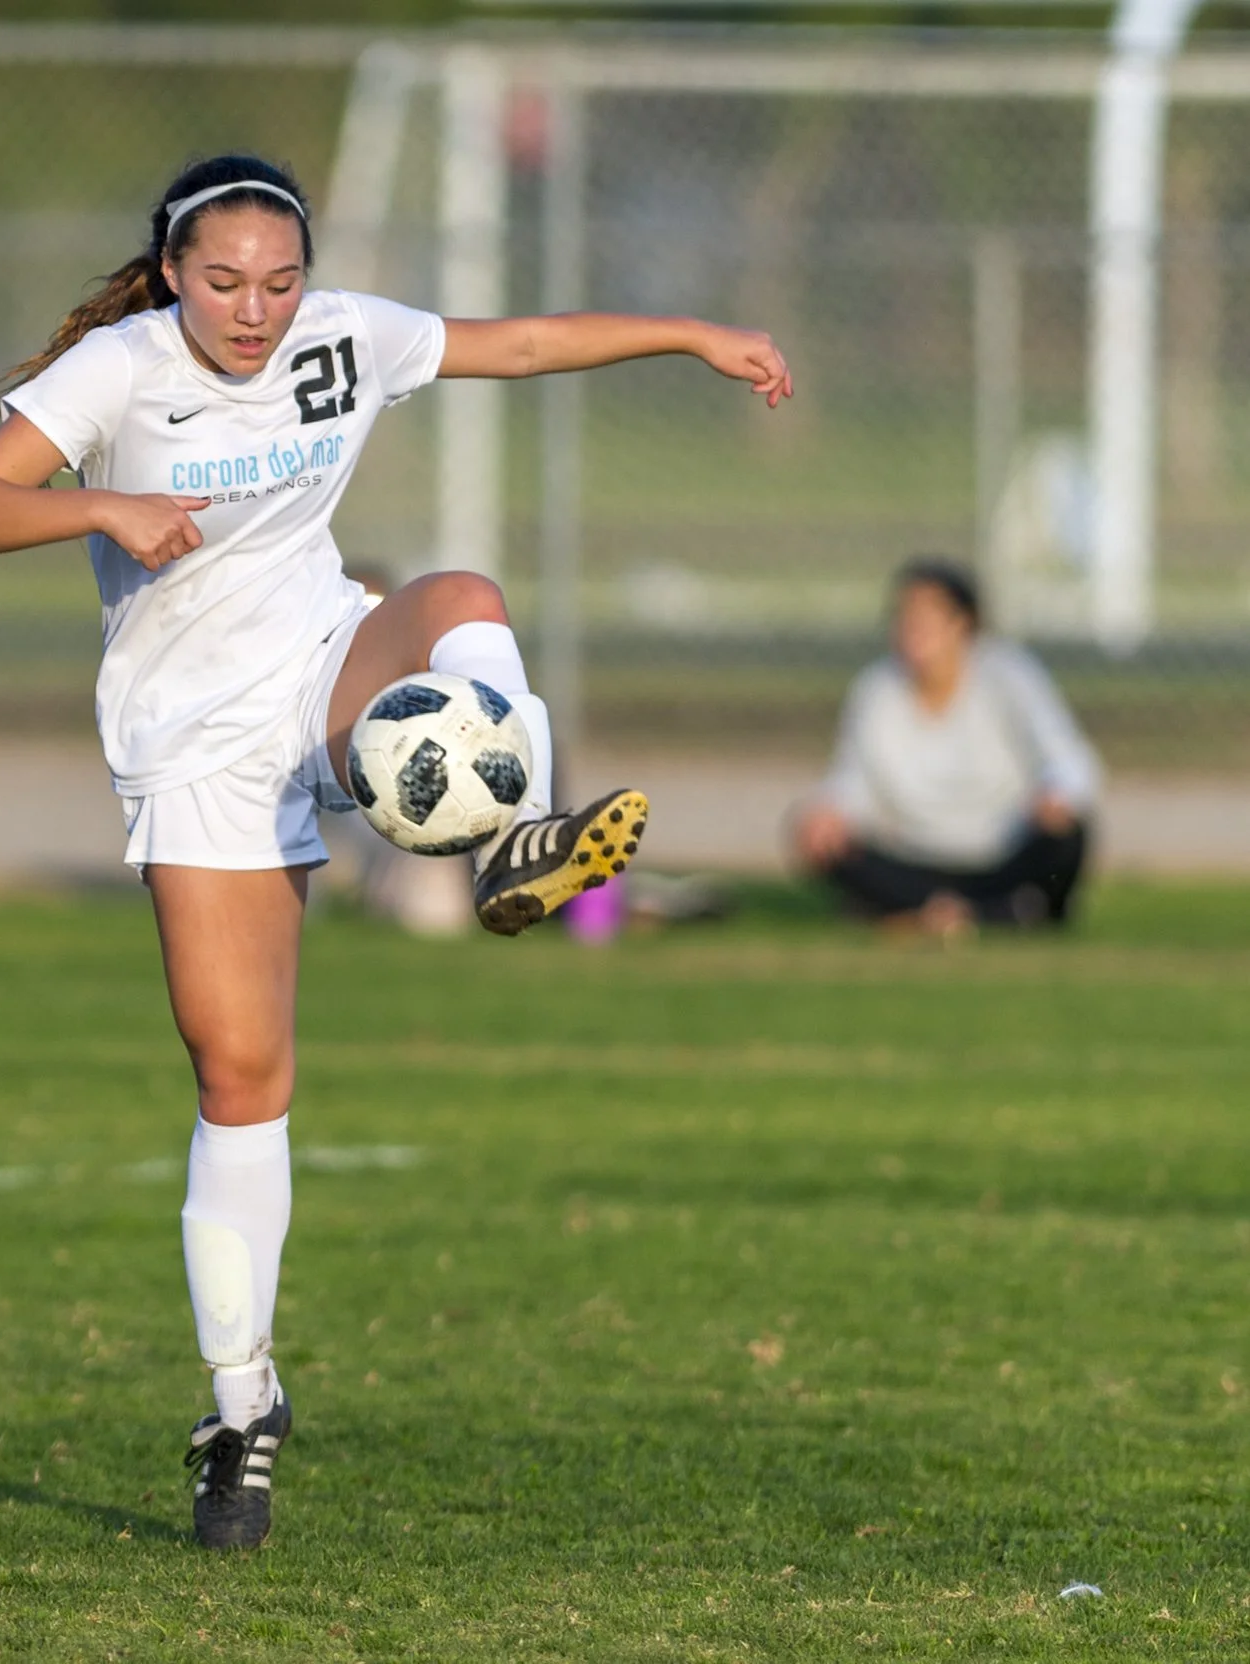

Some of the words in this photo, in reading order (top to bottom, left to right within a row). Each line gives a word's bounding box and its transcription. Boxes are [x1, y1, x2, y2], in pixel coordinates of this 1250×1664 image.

[291, 336, 357, 425] 21
[172, 454, 260, 490] corona
[268, 439, 305, 478] del
[310, 434, 345, 469] mar
[212, 489, 258, 504] SEA
[265, 474, 323, 496] KINGS
